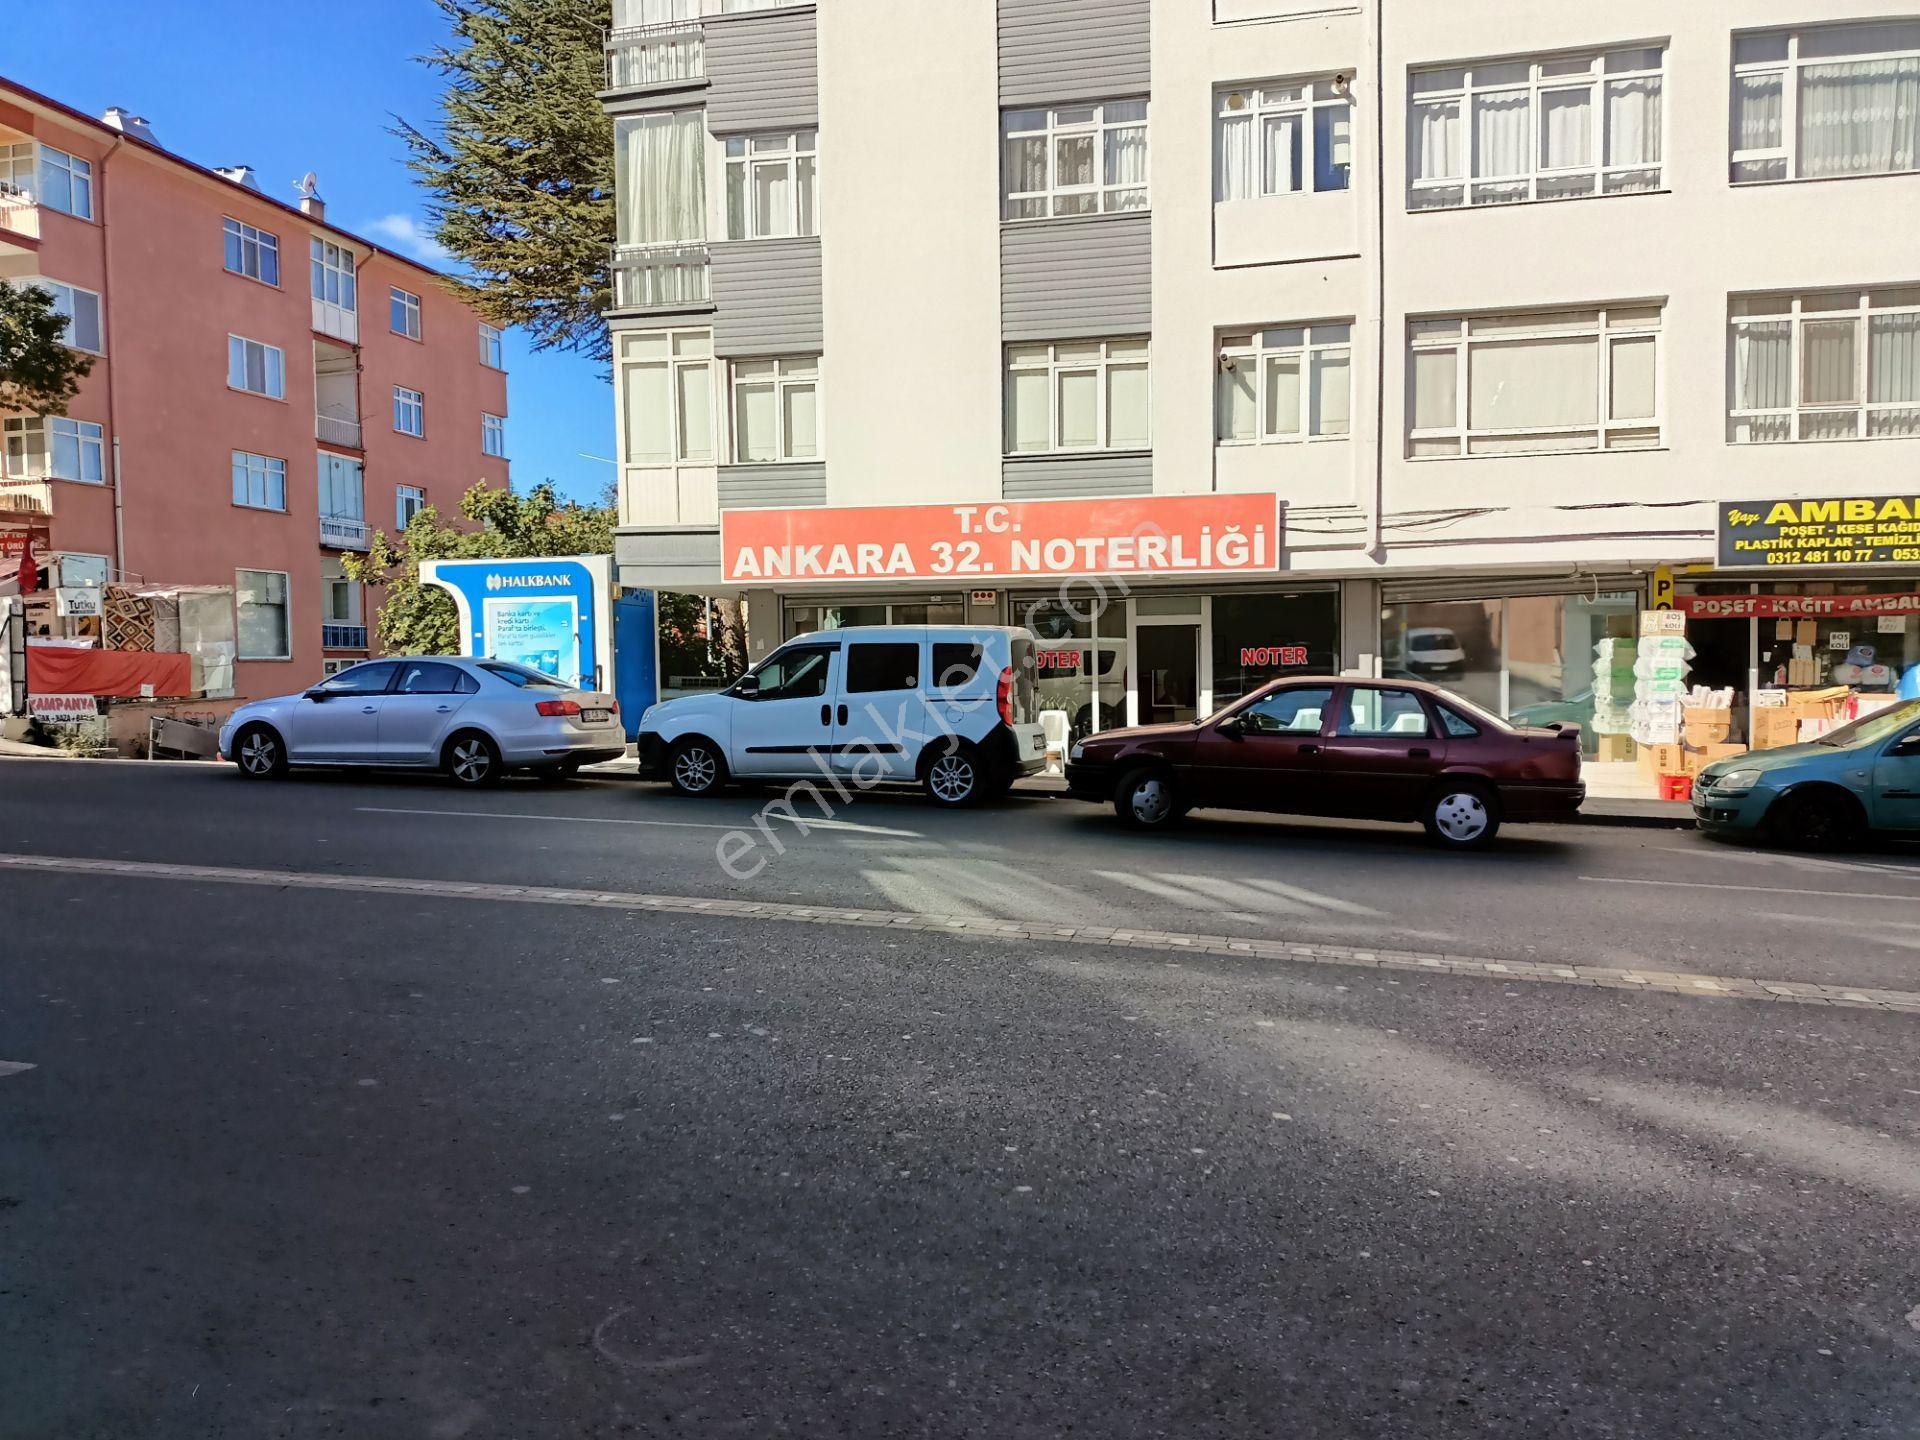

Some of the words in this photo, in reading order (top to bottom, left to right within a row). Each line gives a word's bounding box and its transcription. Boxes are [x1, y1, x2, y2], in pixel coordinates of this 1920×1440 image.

[954, 506, 1021, 533] T.C.
[1764, 498, 1920, 524] AMBA
[1780, 525, 1825, 538] POŞET
[1837, 524, 1874, 535] KESE
[732, 543, 916, 578] ANKARA
[930, 541, 994, 573] 32.
[1011, 524, 1266, 571] NOTERLİĞİ
[1735, 537, 1794, 550] PLASTİK
[1797, 537, 1853, 548] KAPLAR
[1767, 551, 1800, 564] 0312
[1804, 550, 1829, 563] 481
[1834, 550, 1851, 562] 10
[1855, 550, 1873, 561] 77
[1893, 548, 1920, 560] 053
[502, 574, 571, 588] HALKBANK
[68, 600, 96, 609] Tutku
[1693, 599, 1756, 616] POŞET
[1772, 597, 1835, 613] KAĞIT
[1036, 649, 1081, 669] OTER
[1241, 647, 1308, 666] NOTER
